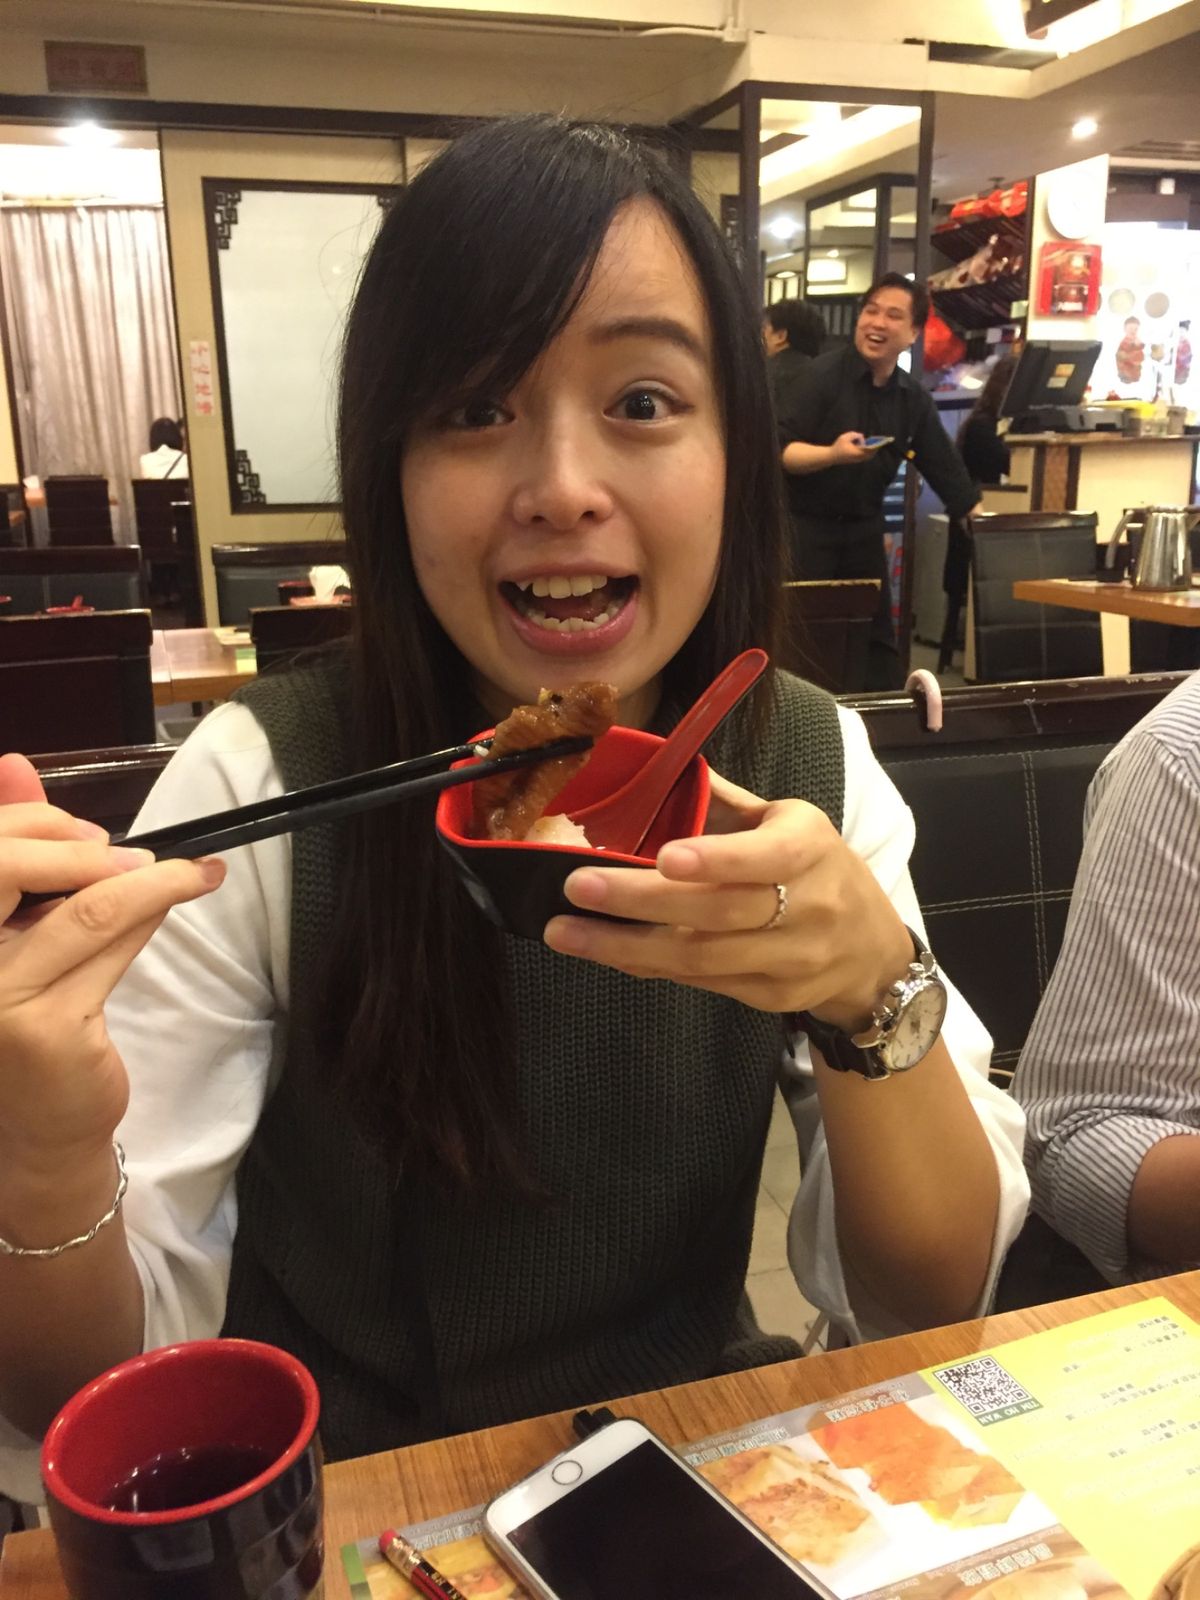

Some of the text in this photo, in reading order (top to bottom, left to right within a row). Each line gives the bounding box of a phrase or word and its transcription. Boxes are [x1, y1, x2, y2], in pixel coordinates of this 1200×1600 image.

[978, 1399, 1040, 1425] TIM HO WAN
